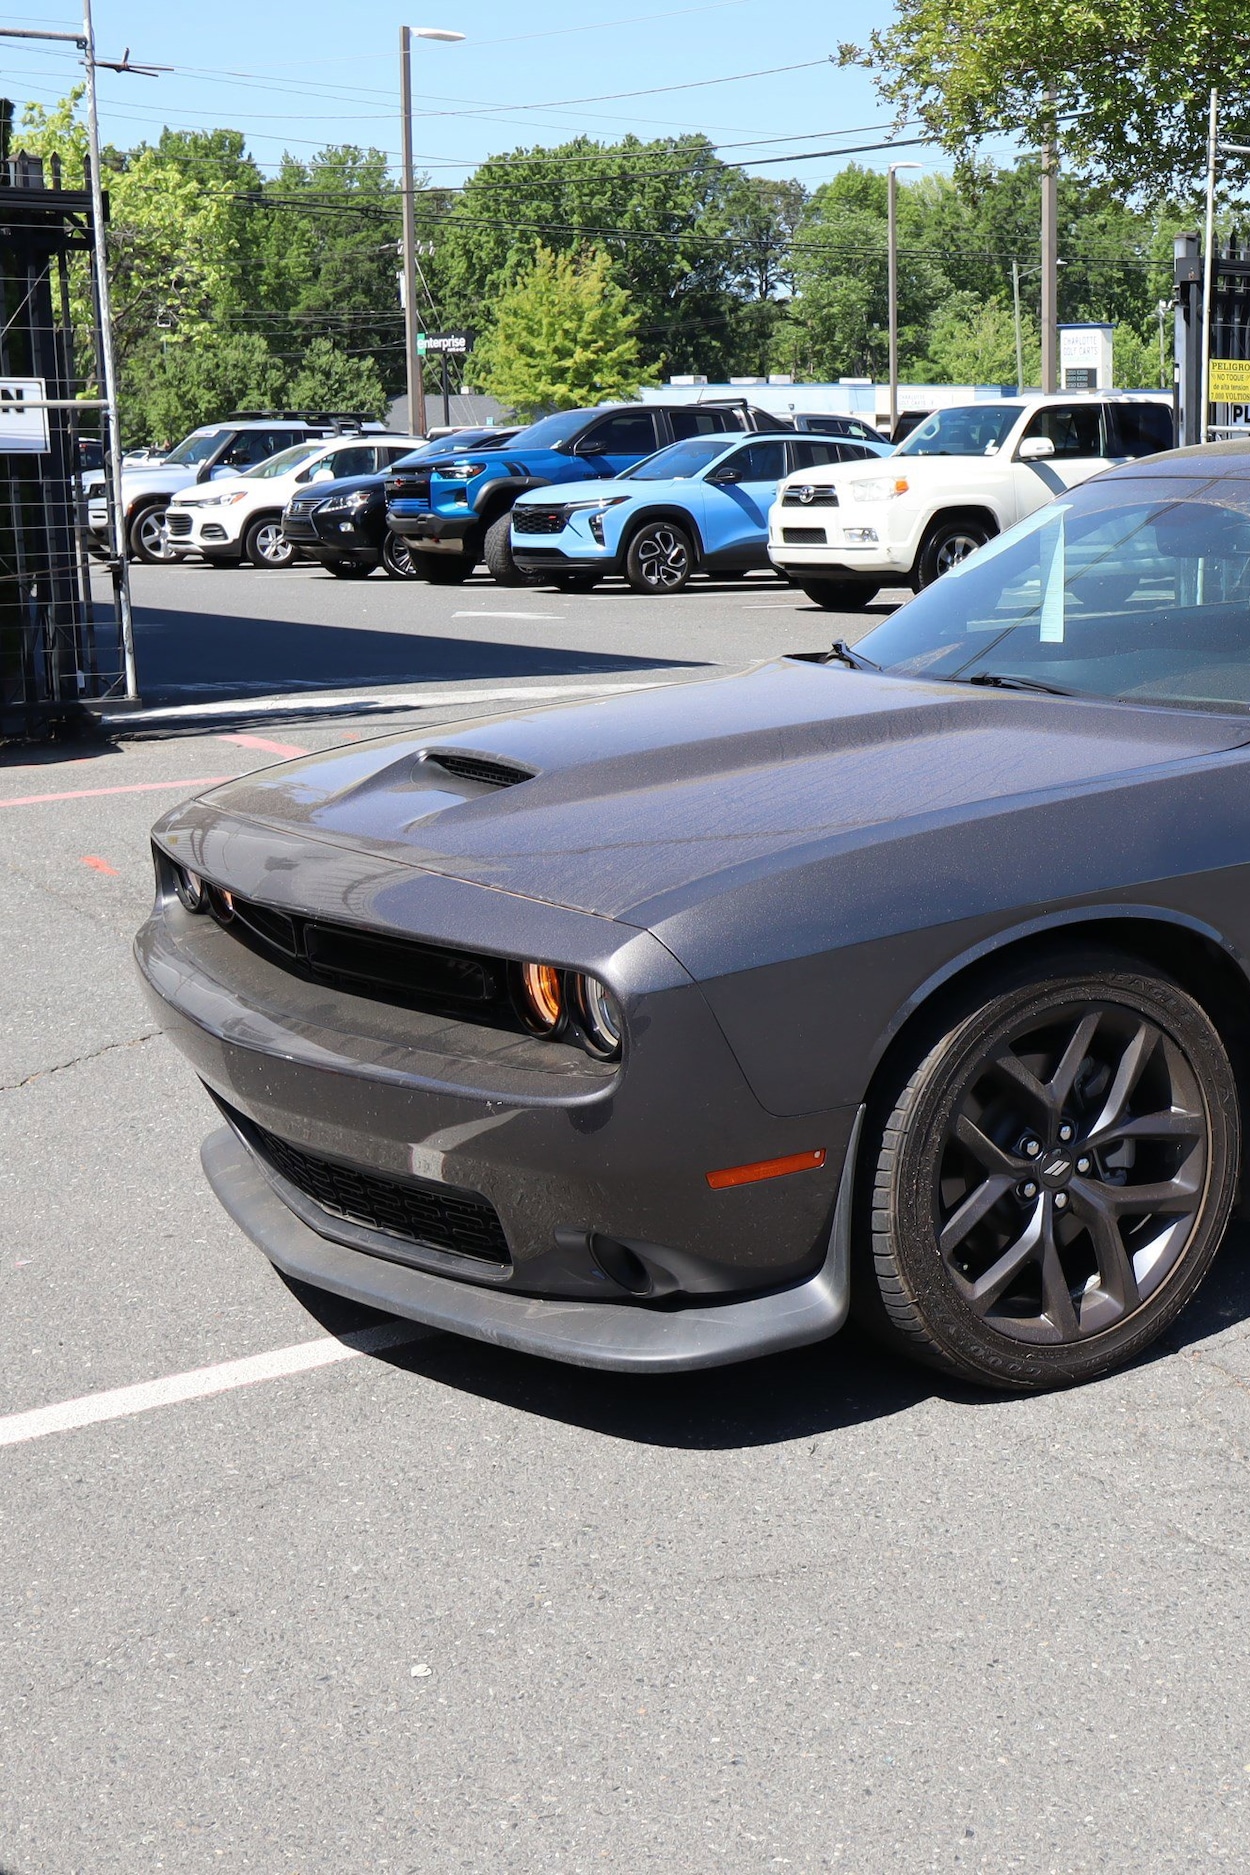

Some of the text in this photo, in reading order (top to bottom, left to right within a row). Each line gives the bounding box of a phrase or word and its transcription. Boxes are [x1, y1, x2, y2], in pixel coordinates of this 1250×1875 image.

[416, 334, 466, 351] enterprise
[1211, 361, 1250, 371] PELIGRO
[1216, 373, 1245, 382] NO TOQUE
[1225, 392, 1250, 401] VOLTIOS
